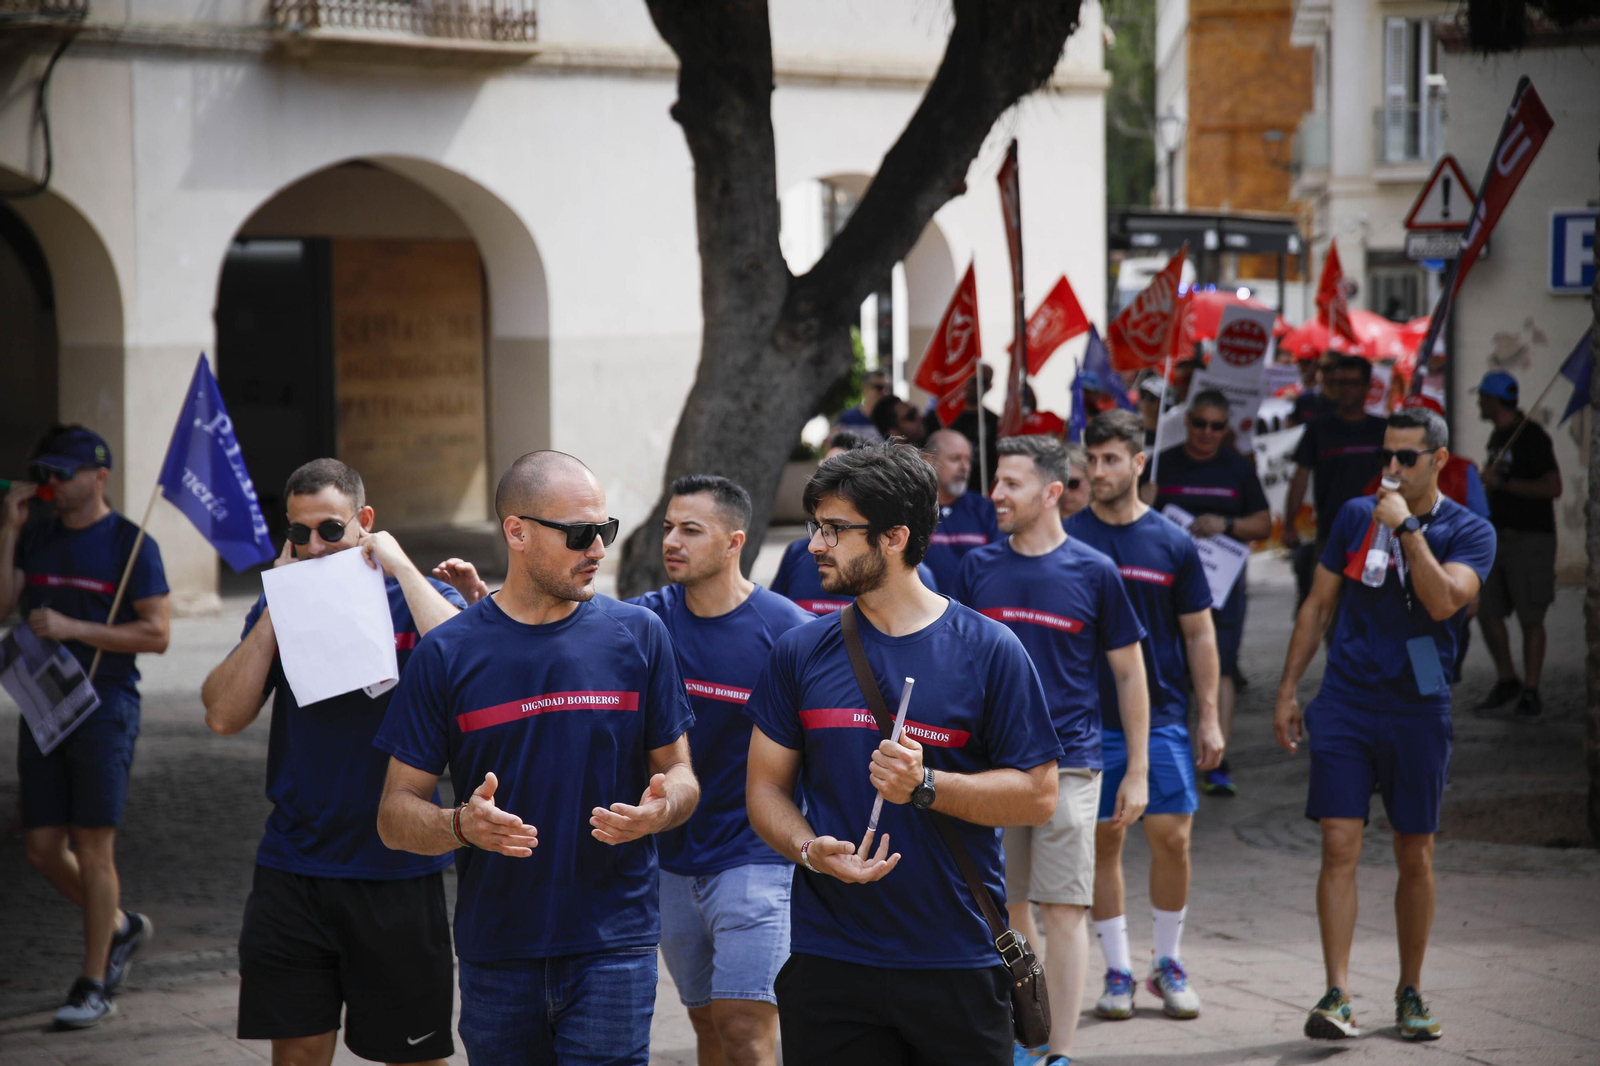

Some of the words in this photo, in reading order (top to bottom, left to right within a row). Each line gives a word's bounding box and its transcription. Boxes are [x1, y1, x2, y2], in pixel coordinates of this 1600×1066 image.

[1002, 610, 1034, 619] DIGNIDAD
[1034, 613, 1072, 628] BOMBEROS
[685, 683, 714, 694] GNIDAD
[715, 687, 750, 700] BOMBER
[521, 696, 565, 713] DIGNIDAD
[567, 696, 620, 705] BOMBEROS
[853, 713, 877, 725] DIGN
[901, 724, 951, 743] OMBEROS
